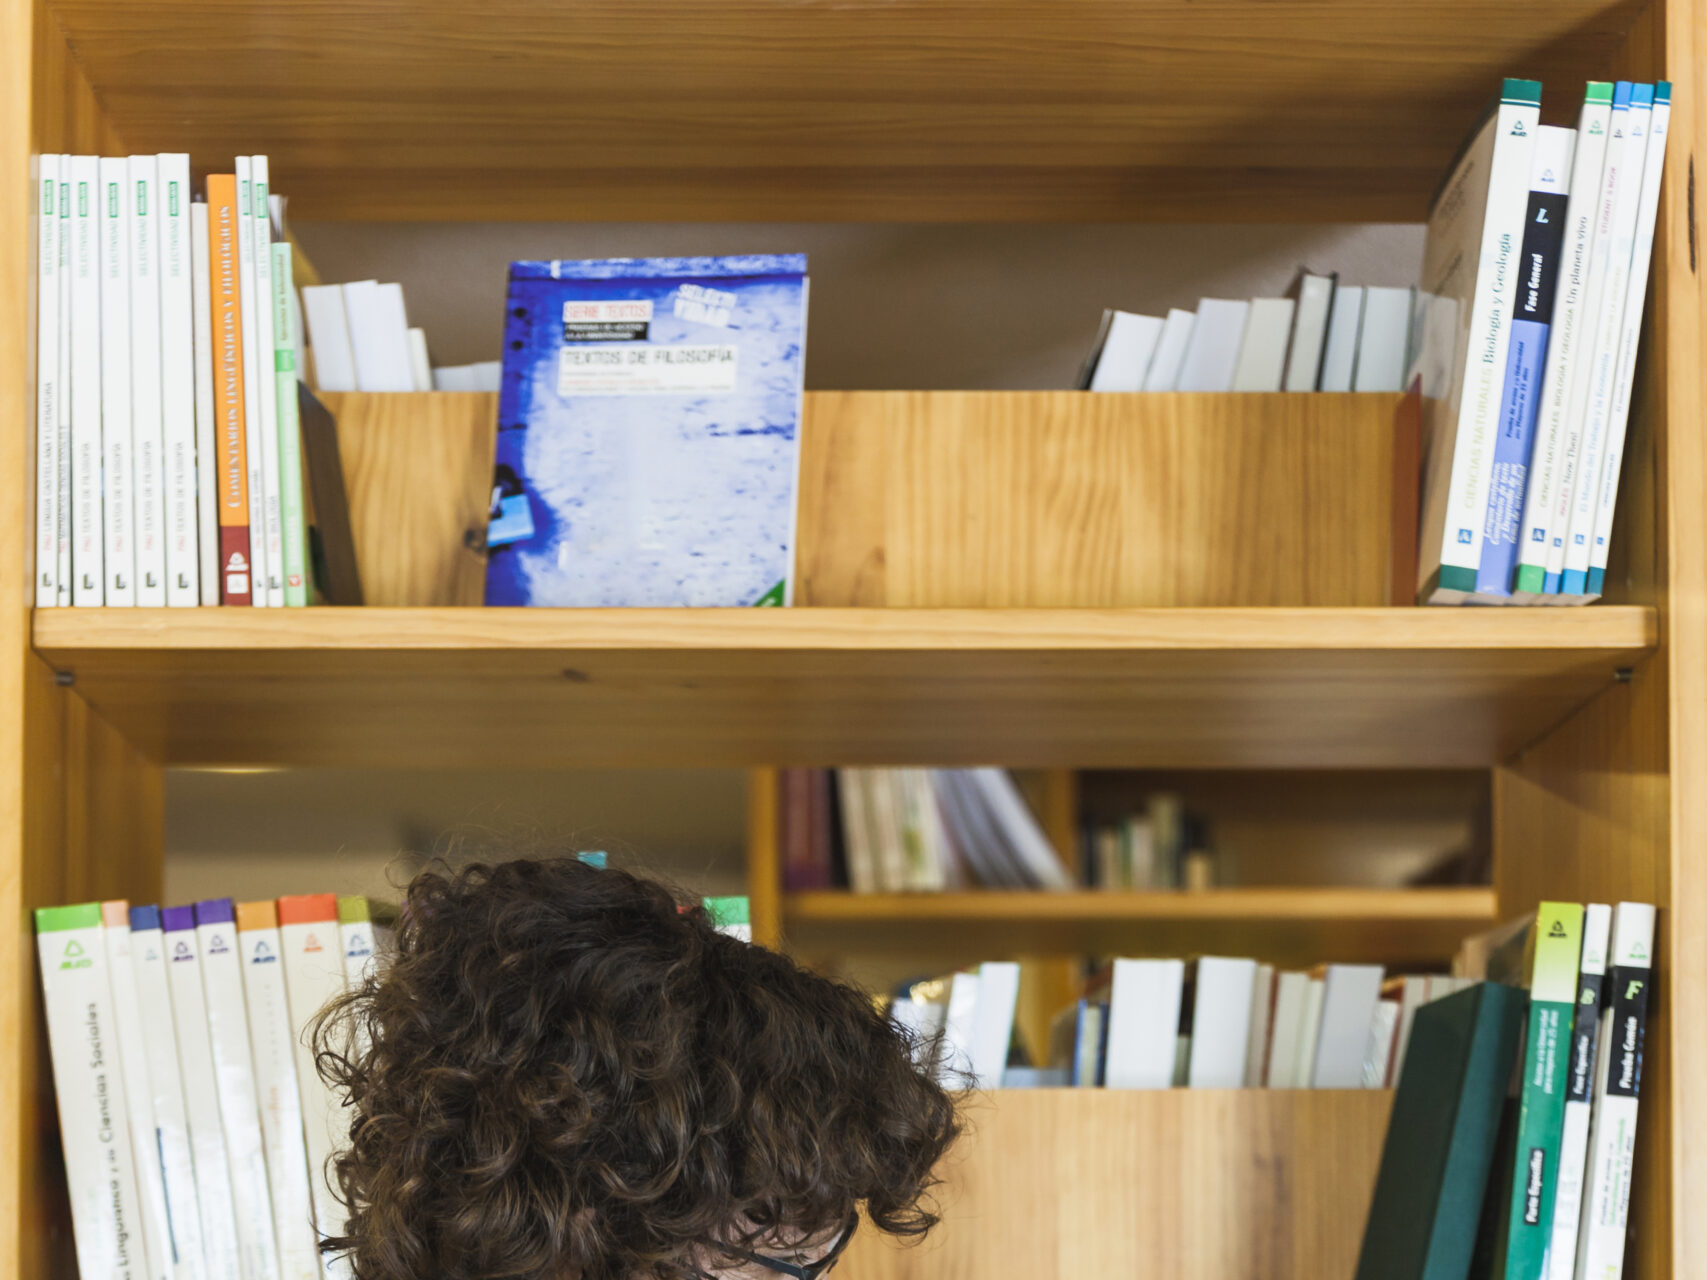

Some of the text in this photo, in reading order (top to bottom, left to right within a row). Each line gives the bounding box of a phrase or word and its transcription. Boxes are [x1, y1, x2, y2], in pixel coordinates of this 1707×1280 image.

[1578, 216, 1587, 238] vivo
[1524, 253, 1543, 311] Fase General
[1570, 243, 1584, 284] planeta
[1566, 286, 1578, 303] Un
[1562, 308, 1574, 354] GEOLOGÍA
[565, 346, 733, 365] TEXTOS DE FILOSOFÍA
[1465, 448, 1481, 507] CIENCIAS
[1473, 369, 1492, 444] NATURALES
[1483, 309, 1501, 363] Biología
[1493, 233, 1511, 292] Geología
[1596, 353, 1610, 398] Economía
[1554, 365, 1566, 405] BIOLOGÍA
[1587, 417, 1601, 450] Trabajo
[1586, 453, 1594, 467] del
[1540, 466, 1552, 507] CIENCIAS
[1581, 469, 1592, 500] Mundo
[87, 1003, 103, 1067] Sociales
[1619, 1016, 1637, 1088] Prueba Común
[96, 1074, 112, 1143] Ciencias
[1525, 1195, 1538, 1222] Parte
